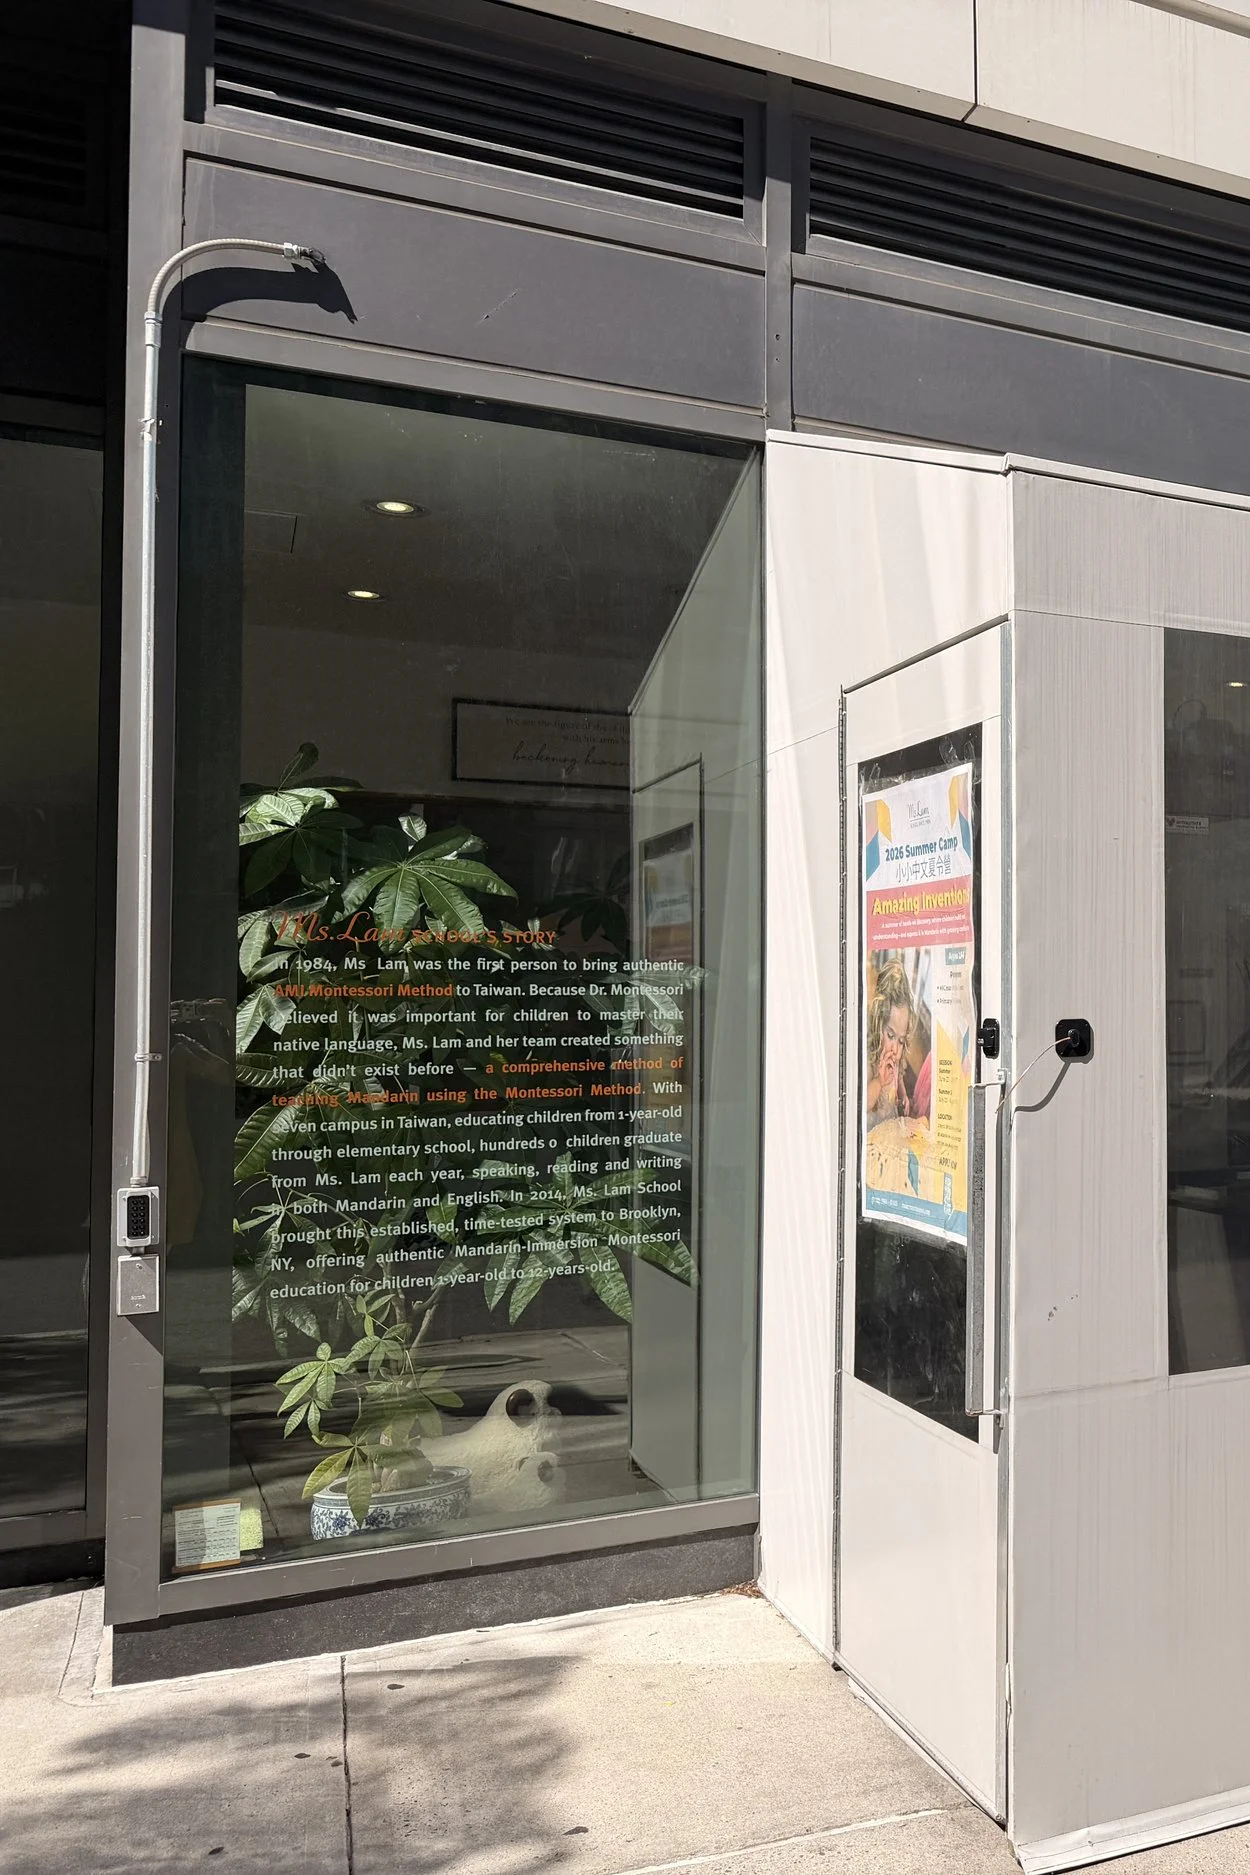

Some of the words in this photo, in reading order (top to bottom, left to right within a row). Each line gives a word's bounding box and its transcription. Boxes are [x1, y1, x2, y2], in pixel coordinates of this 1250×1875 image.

[885, 845, 904, 861] 2026
[906, 841, 937, 858] Summer
[938, 836, 958, 851] Camp
[873, 892, 920, 916] Amazing
[503, 931, 556, 943] STORY
[296, 958, 337, 972] 1984,
[378, 958, 406, 970] Lam
[414, 960, 441, 970] was
[448, 958, 471, 970] the
[477, 958, 504, 970] first
[511, 960, 557, 973] person
[563, 960, 577, 970] to
[583, 959, 618, 973] bring
[623, 959, 684, 970] authentic
[309, 984, 393, 997] Montessori
[398, 984, 453, 997] Method
[456, 986, 470, 996] to
[473, 984, 525, 996] Taiwan.
[529, 984, 586, 996] Because
[589, 984, 607, 996] Dr.
[611, 983, 684, 996] Montessori
[277, 1011, 337, 1023] elieved
[349, 1012, 358, 1023] it
[368, 1013, 396, 1023] was
[406, 1011, 476, 1025] important
[486, 1010, 505, 1022] for
[513, 1009, 568, 1021] children
[577, 1010, 591, 1021] to
[600, 1010, 645, 1020] master
[653, 1009, 683, 1020] their
[274, 1038, 320, 1051] native
[325, 1038, 397, 1052] language,
[403, 1037, 427, 1049] Ms.
[433, 1037, 461, 1048] Lam
[466, 1035, 491, 1048] and
[496, 1035, 519, 1047] her
[523, 1036, 556, 1047] team
[560, 1034, 610, 1046] created
[614, 1033, 683, 1046] something
[273, 1066, 304, 1078] that
[365, 1063, 400, 1076] exist
[408, 1063, 454, 1075] before
[485, 1064, 494, 1073] a
[502, 1059, 605, 1075] comprehensive
[612, 1058, 662, 1071] method
[670, 1056, 683, 1069] of
[272, 1091, 339, 1108] teaching
[347, 1090, 418, 1104] Mandarin
[427, 1089, 466, 1103] using
[474, 1088, 497, 1100] the
[506, 1085, 583, 1099] Montessori
[591, 1083, 645, 1096] Method.
[653, 1082, 682, 1094] With
[320, 1119, 377, 1133] campus
[382, 1117, 394, 1129] in
[399, 1115, 451, 1129] Taiwan,
[455, 1111, 524, 1126] educating
[526, 1110, 581, 1123] children
[585, 1109, 614, 1121] from
[618, 1106, 682, 1122] 1-year-old
[272, 1146, 332, 1161] through
[336, 1143, 420, 1159] elementary
[424, 1140, 474, 1154] school,
[480, 1137, 544, 1151] hundreds
[566, 1134, 619, 1148] children
[624, 1132, 682, 1145] graduate
[272, 1175, 306, 1188] from
[316, 1174, 342, 1187] Ms.
[351, 1172, 380, 1184] Lam
[389, 1169, 423, 1182] each
[431, 1169, 465, 1183] year,
[473, 1164, 539, 1180] speaking,
[547, 1161, 598, 1174] reading
[605, 1158, 629, 1170] and
[637, 1157, 682, 1169] writing
[293, 1202, 327, 1215] both
[336, 1197, 405, 1212] Mandarin
[413, 1194, 439, 1207] and
[448, 1192, 503, 1207] English.
[511, 1190, 522, 1201] In
[531, 1190, 566, 1201] 2014,
[573, 1186, 597, 1197] Ms.
[604, 1184, 630, 1195] Lam
[637, 1180, 681, 1193] School
[272, 1228, 331, 1245] brought
[337, 1225, 365, 1239] this
[370, 1221, 459, 1237] established,
[464, 1213, 543, 1231] time-tested
[549, 1212, 596, 1227] system
[601, 1211, 614, 1221] to
[619, 1206, 681, 1220] Brooklyn,
[271, 1257, 295, 1271] NY,
[306, 1253, 365, 1269] offering
[376, 1246, 444, 1263] authentic
[455, 1237, 598, 1256] Mandarin-Immersion
[608, 1229, 681, 1246] Montessori
[270, 1282, 345, 1299] education
[350, 1279, 370, 1292] for
[375, 1273, 433, 1290] children
[437, 1271, 506, 1287] 1-year-old
[511, 1268, 525, 1279] to
[528, 1260, 615, 1279] 12-years-old.
